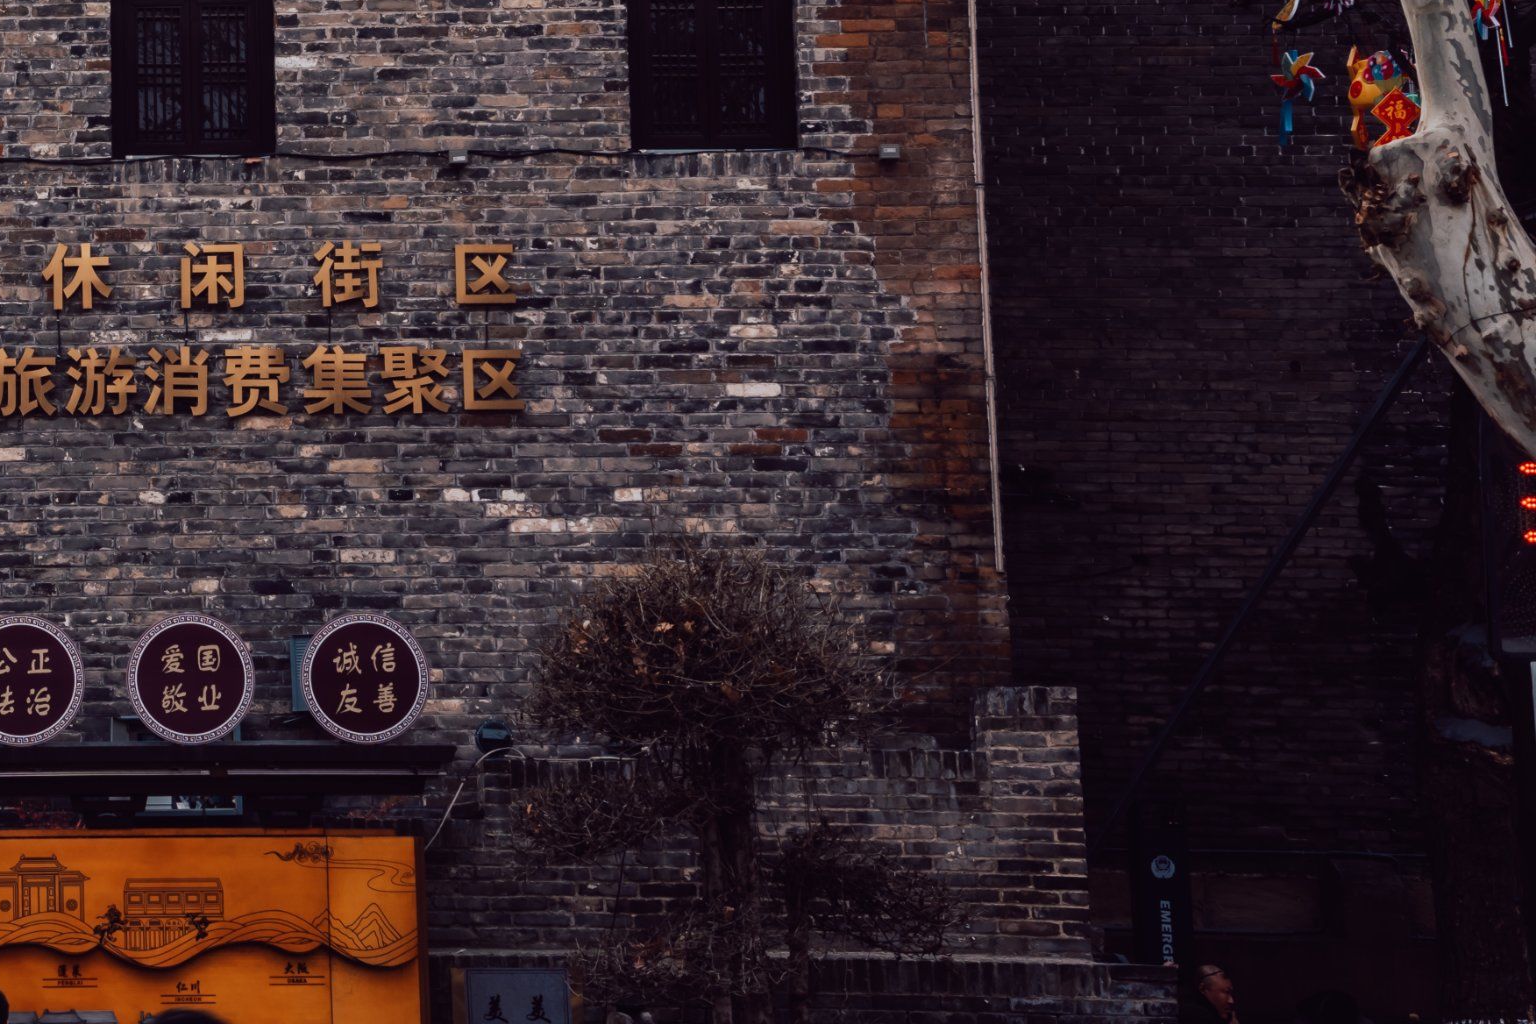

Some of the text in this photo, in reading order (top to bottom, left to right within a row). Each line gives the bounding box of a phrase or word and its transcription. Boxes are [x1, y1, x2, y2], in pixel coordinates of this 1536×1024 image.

[1385, 100, 1406, 119] 福
[161, 644, 220, 673] 爱国
[333, 642, 396, 674] 诚信
[161, 682, 222, 714] 敬业
[336, 682, 398, 714] 友善
